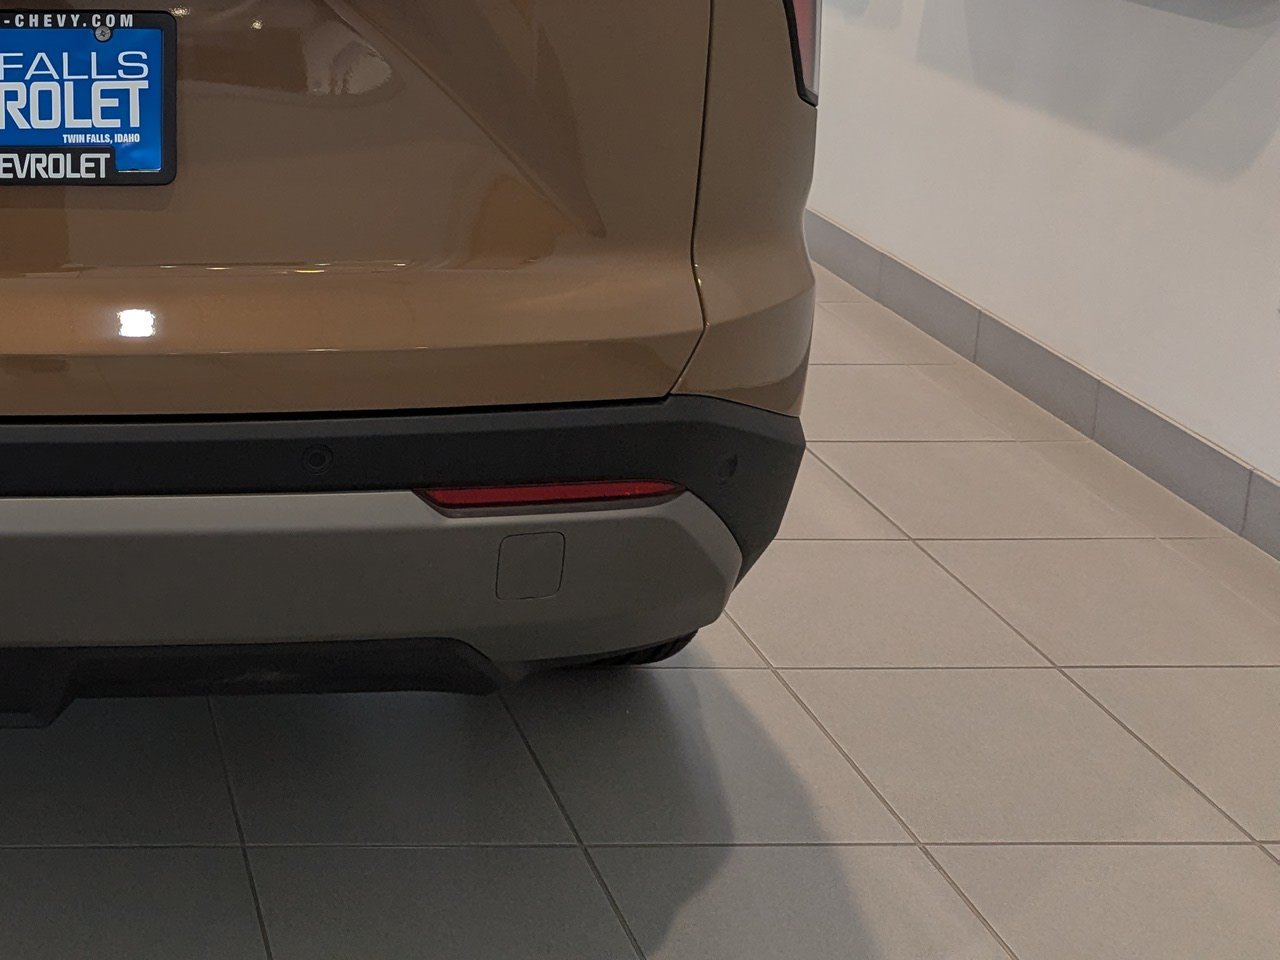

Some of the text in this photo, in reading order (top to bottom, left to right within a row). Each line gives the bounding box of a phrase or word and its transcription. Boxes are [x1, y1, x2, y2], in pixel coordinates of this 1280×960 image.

[62, 133, 140, 144] TWIN FALLS, IDAHO
